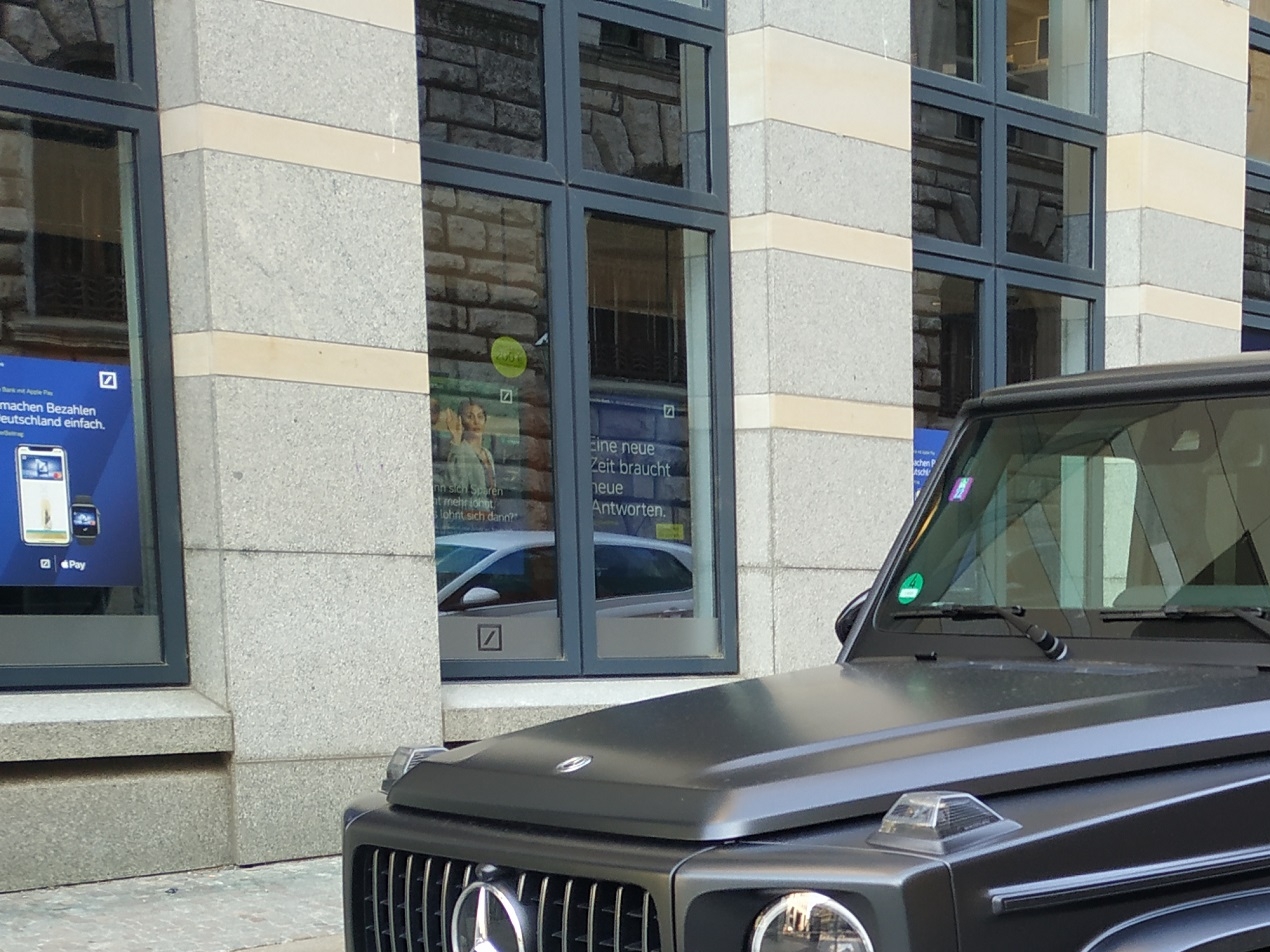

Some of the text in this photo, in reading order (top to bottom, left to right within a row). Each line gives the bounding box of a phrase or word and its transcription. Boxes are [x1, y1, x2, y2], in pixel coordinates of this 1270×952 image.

[46, 402, 97, 416] Bezahlen
[64, 417, 106, 430] einfach.
[621, 441, 656, 456] neue
[591, 456, 671, 478] Zeit braucht
[448, 483, 468, 494] sich
[470, 485, 504, 496] Sparen
[443, 496, 468, 508] mehr
[592, 499, 667, 518] Antworten.
[440, 509, 464, 520] lohnt
[466, 510, 486, 521] sich
[69, 559, 87, 572] Pay
[909, 574, 918, 589] 4
